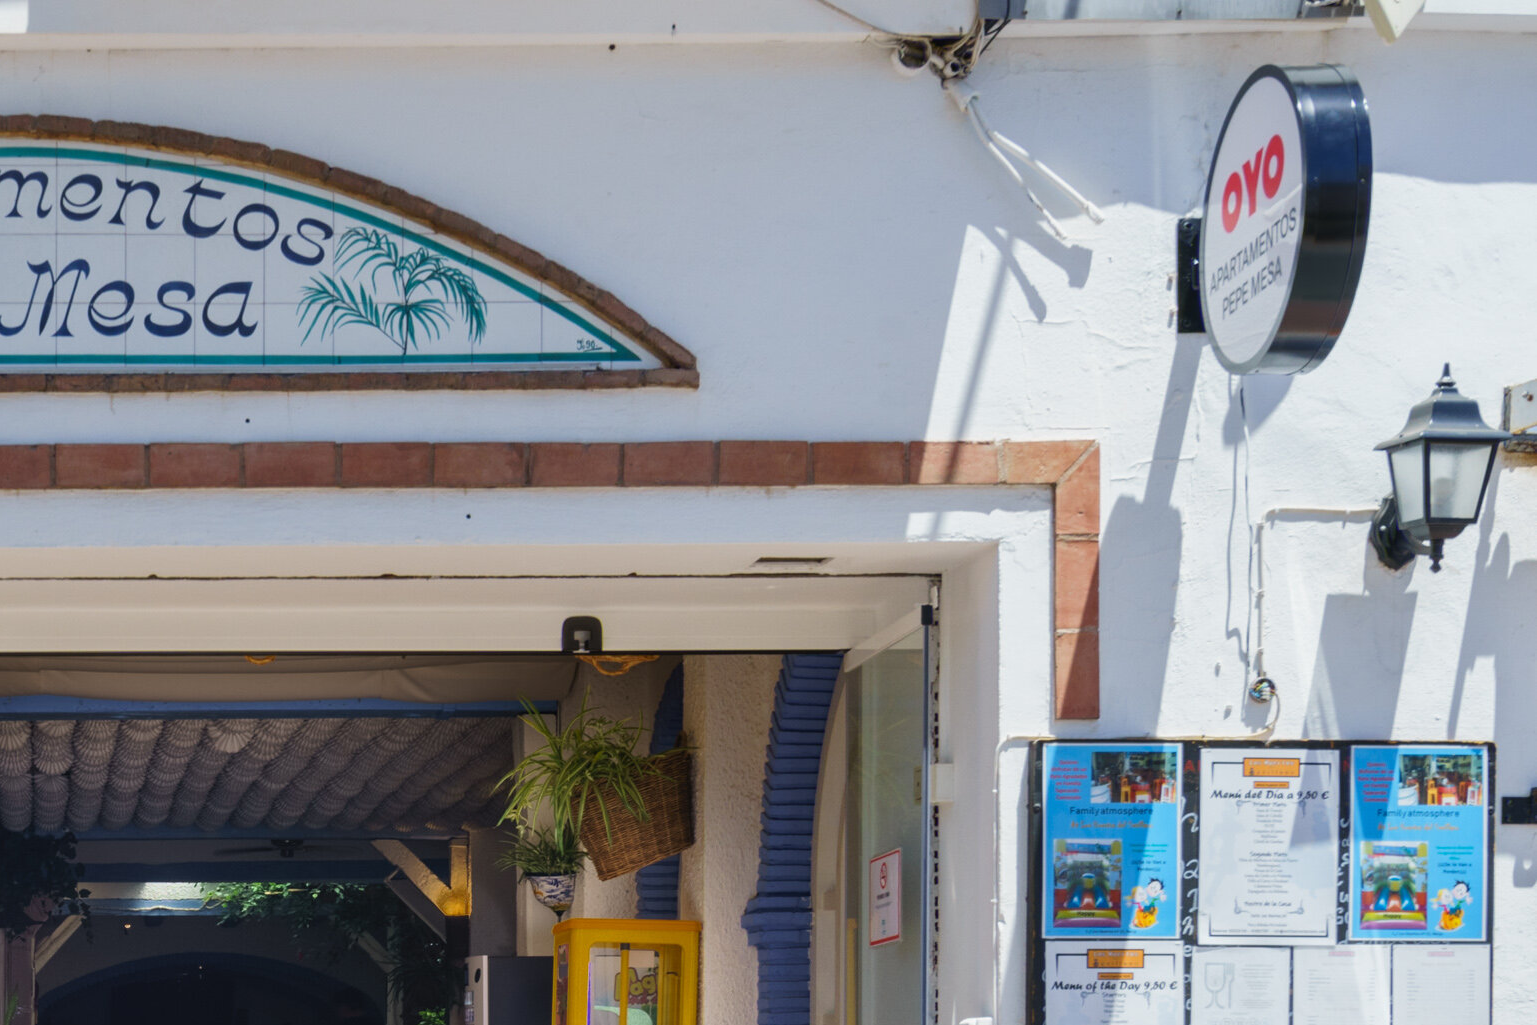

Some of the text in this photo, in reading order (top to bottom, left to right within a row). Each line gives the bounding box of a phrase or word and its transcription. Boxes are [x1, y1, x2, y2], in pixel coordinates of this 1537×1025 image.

[1221, 134, 1285, 233] OYO
[1209, 206, 1297, 293] APARTAMENTOS
[1222, 256, 1283, 321] PEPE MESA
[1211, 789, 1242, 800] Menú
[1244, 790, 1261, 799] del
[1265, 789, 1283, 799] Día
[1297, 790, 1318, 800] 9,50
[1321, 790, 1330, 799] €
[1051, 981, 1178, 992] Menu of the Day 9,50 €
